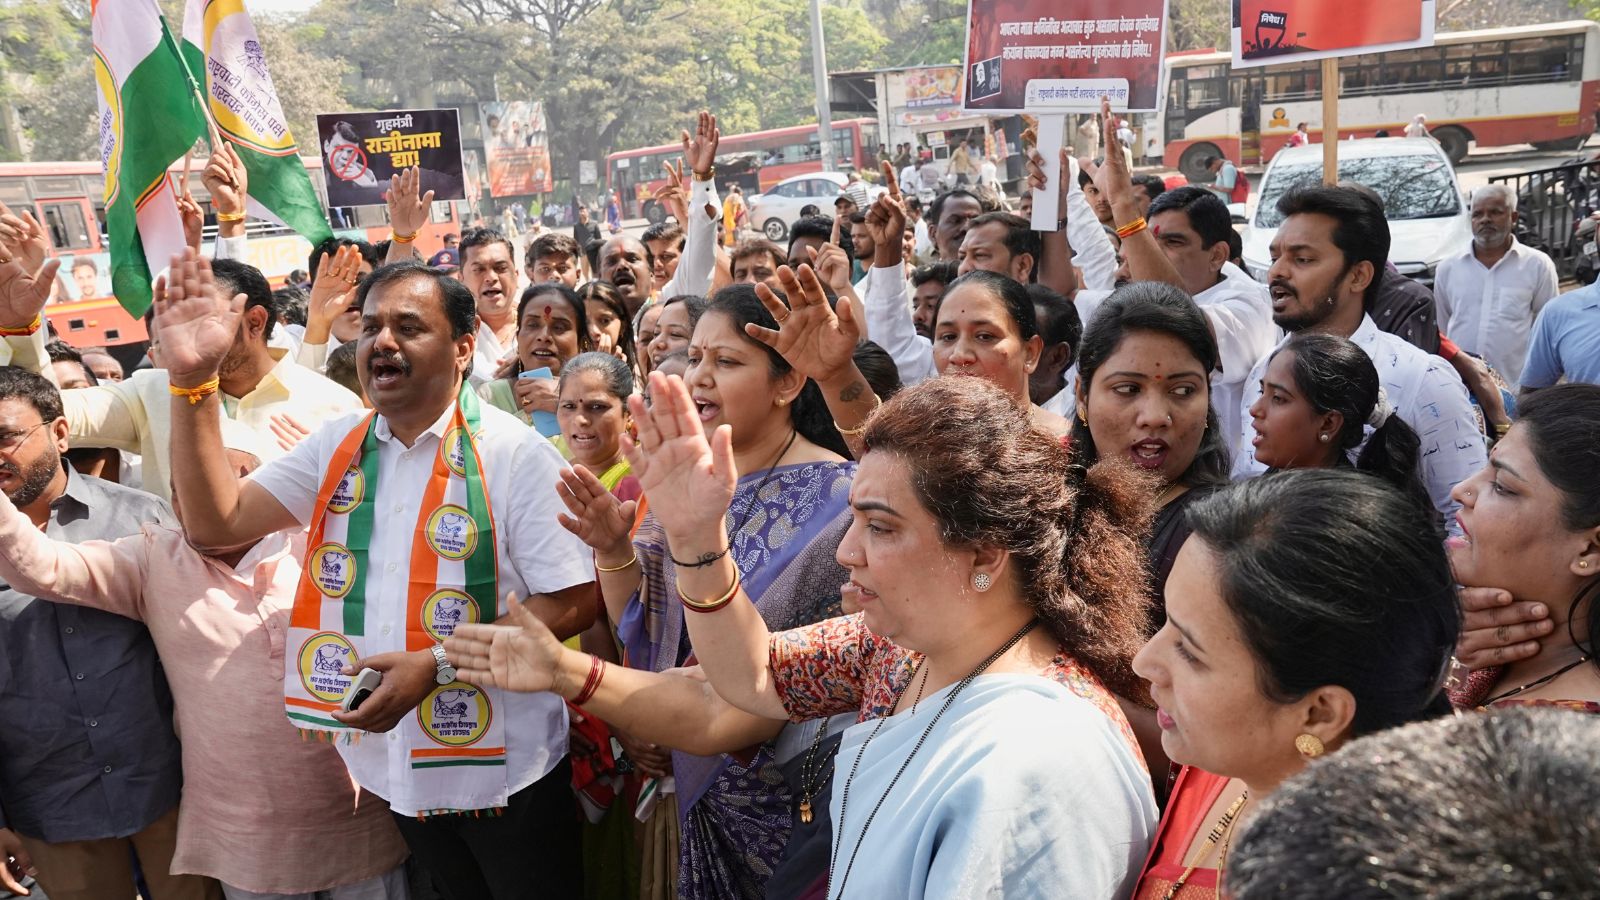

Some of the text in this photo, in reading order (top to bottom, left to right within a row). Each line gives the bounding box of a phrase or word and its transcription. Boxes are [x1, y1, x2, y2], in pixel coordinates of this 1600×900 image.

[208, 56, 241, 89] राष्ट्रवादी
[268, 117, 287, 137] पक्ष
[244, 110, 265, 136] पवार
[376, 114, 413, 135] गृहमंत्री
[365, 130, 441, 155] राजीनामा
[391, 151, 420, 169] द्या!
